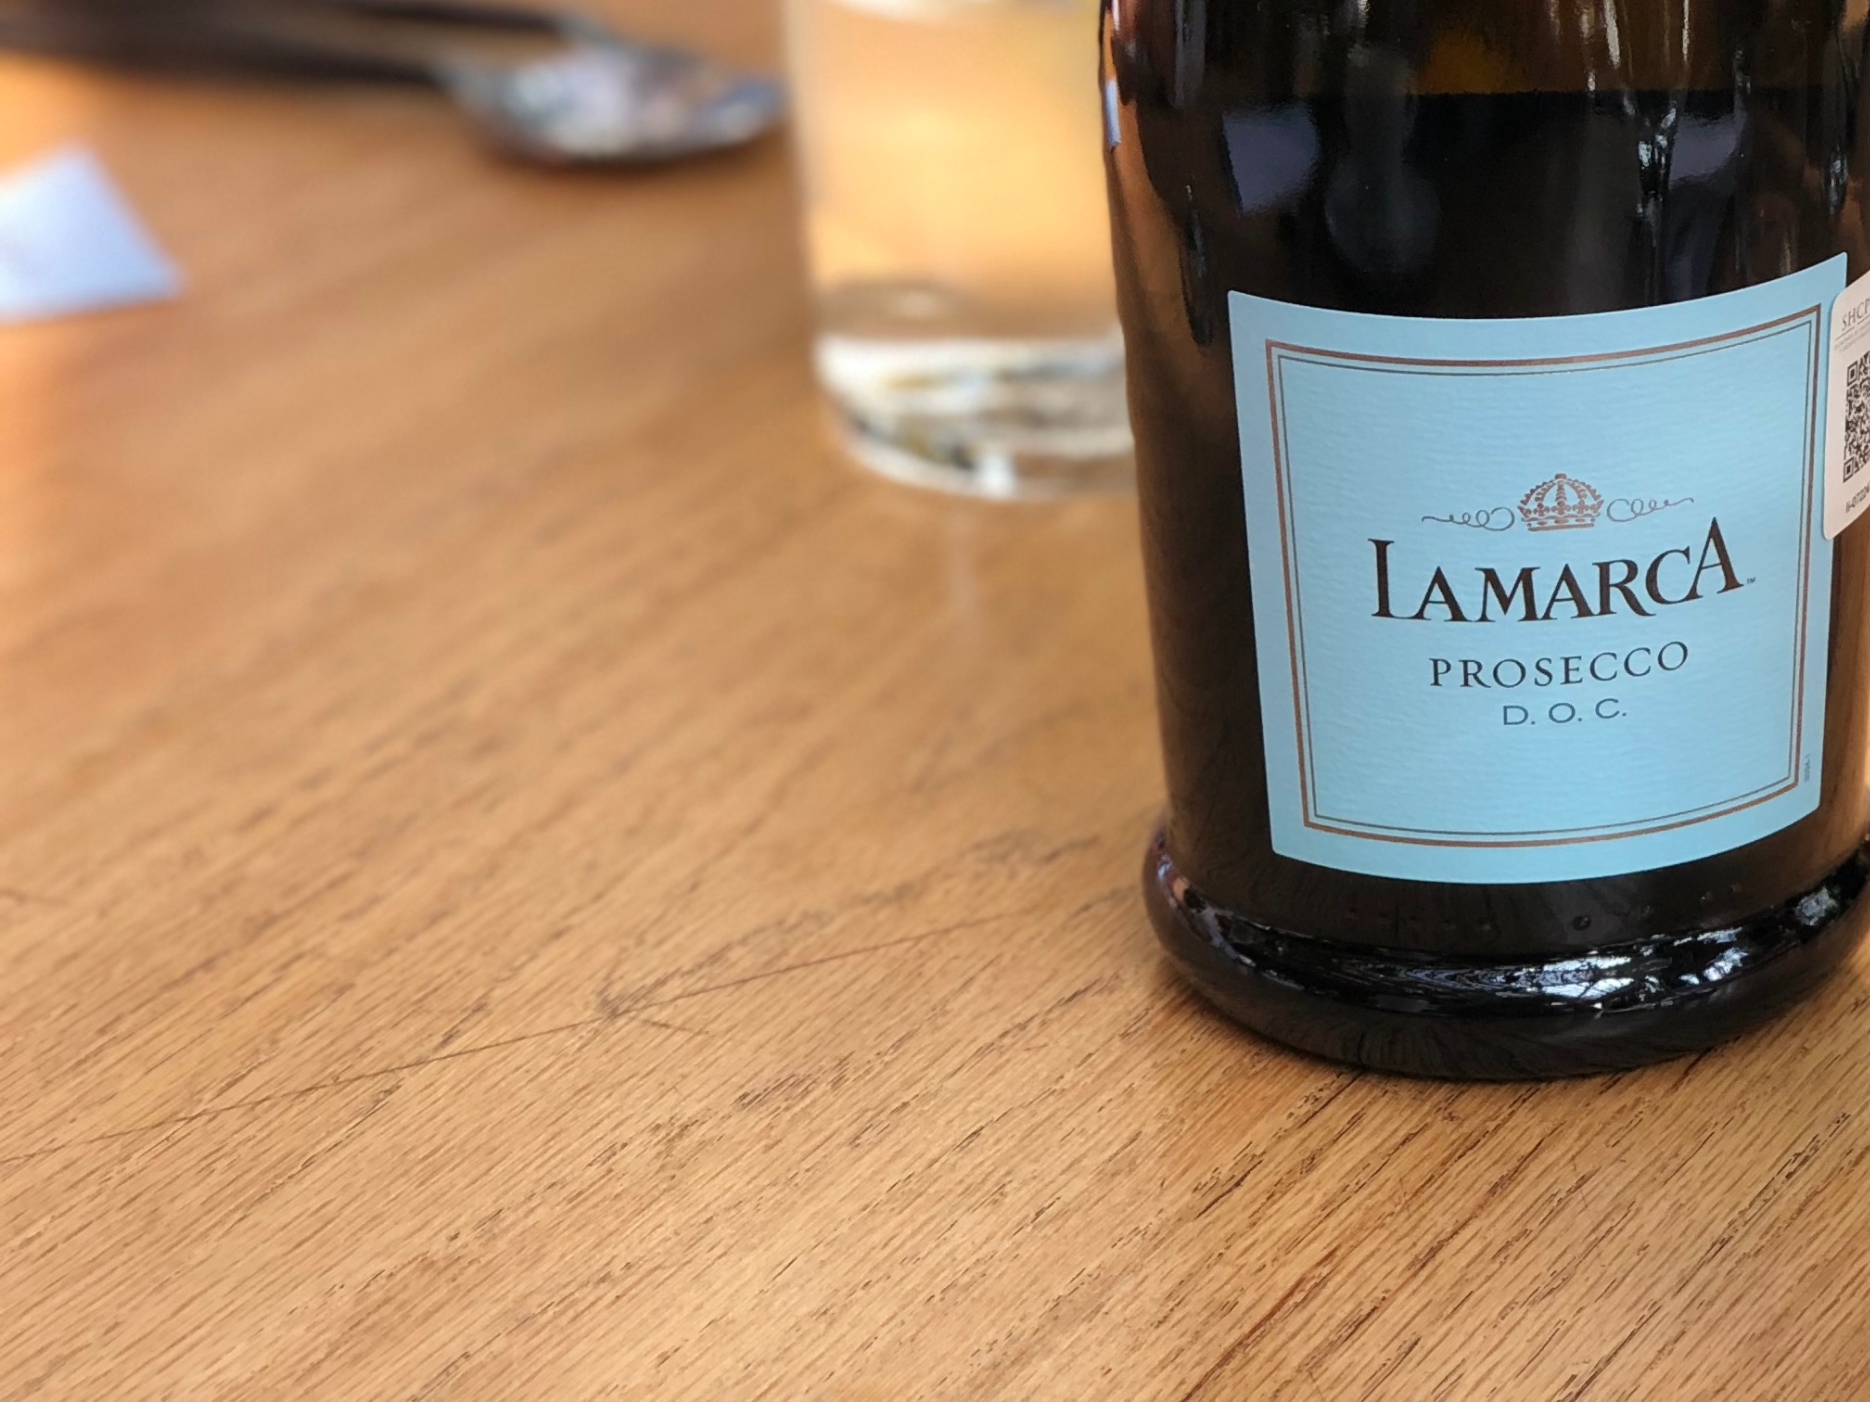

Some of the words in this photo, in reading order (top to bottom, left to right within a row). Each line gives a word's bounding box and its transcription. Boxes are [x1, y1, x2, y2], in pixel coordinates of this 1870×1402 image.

[1841, 297, 1870, 332] SHCP
[1367, 516, 1744, 623] LAMARCA
[1429, 640, 1689, 689] PROSECCO
